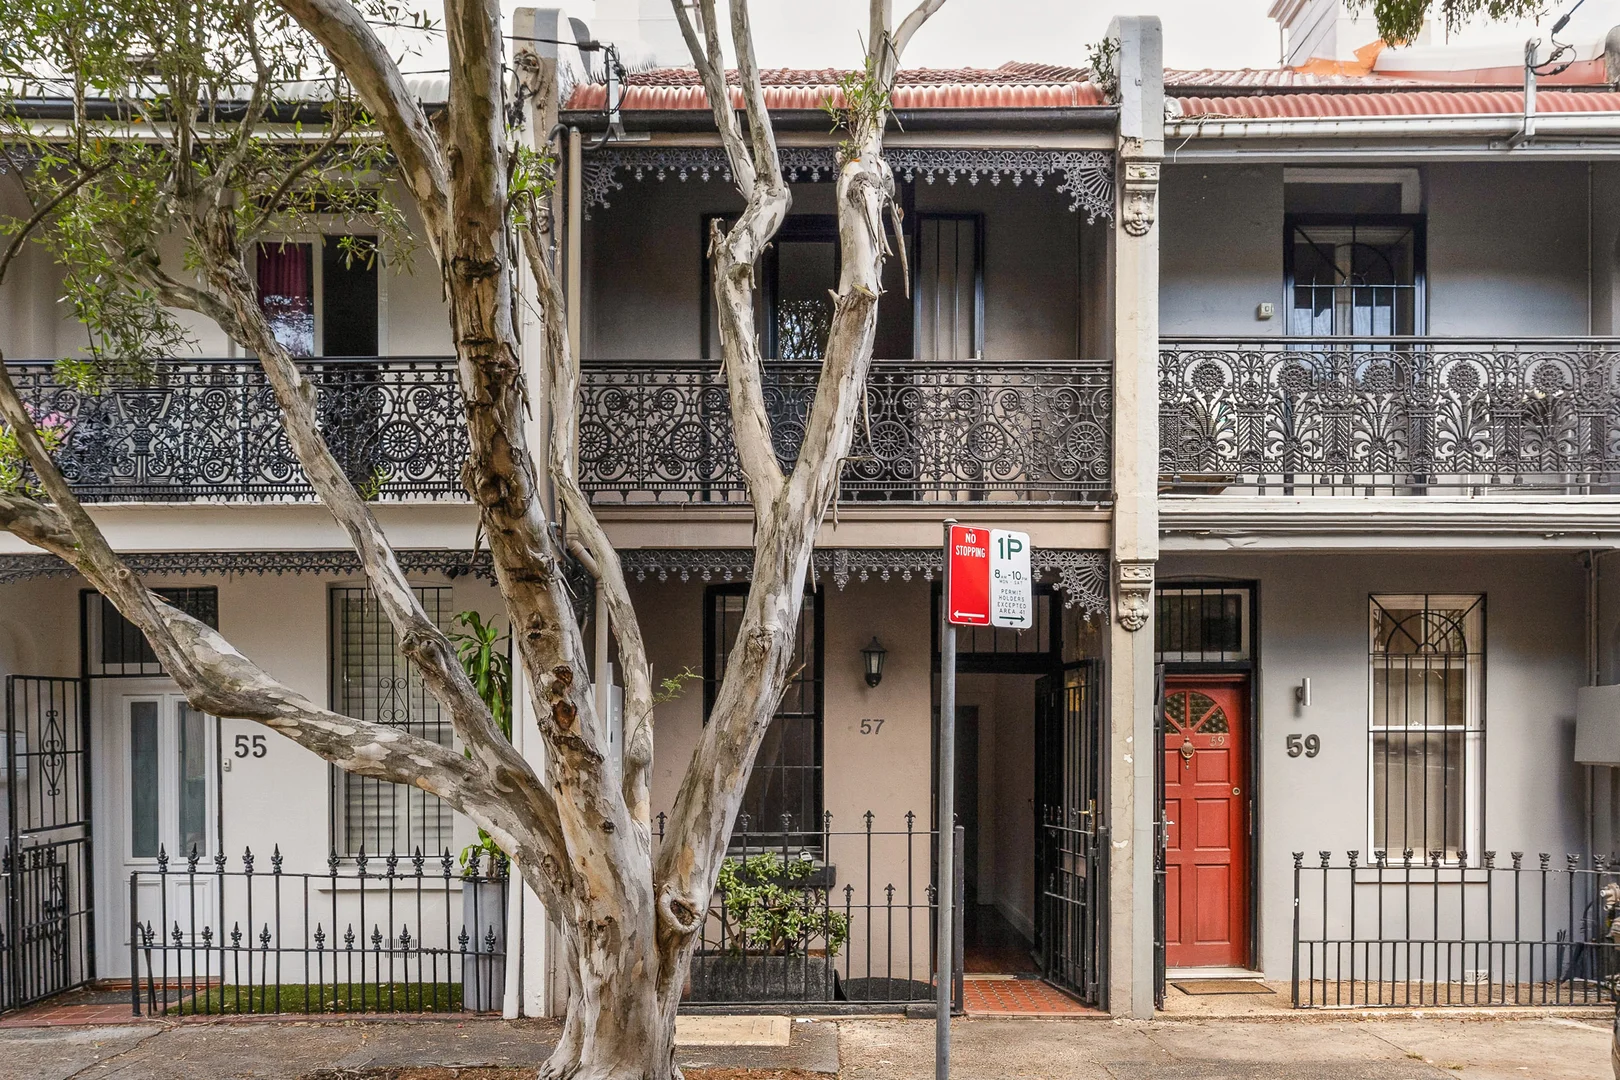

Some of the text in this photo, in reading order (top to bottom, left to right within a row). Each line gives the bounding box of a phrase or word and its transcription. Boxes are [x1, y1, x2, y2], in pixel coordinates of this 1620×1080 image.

[965, 533, 977, 544] NO
[955, 545, 986, 558] STOPPING
[997, 537, 1023, 560] 1P
[997, 601, 1027, 609] EXCEPTED
[860, 719, 885, 735] 57
[234, 735, 267, 758] 55
[1209, 735, 1225, 747] 59
[1286, 734, 1320, 758] 59
